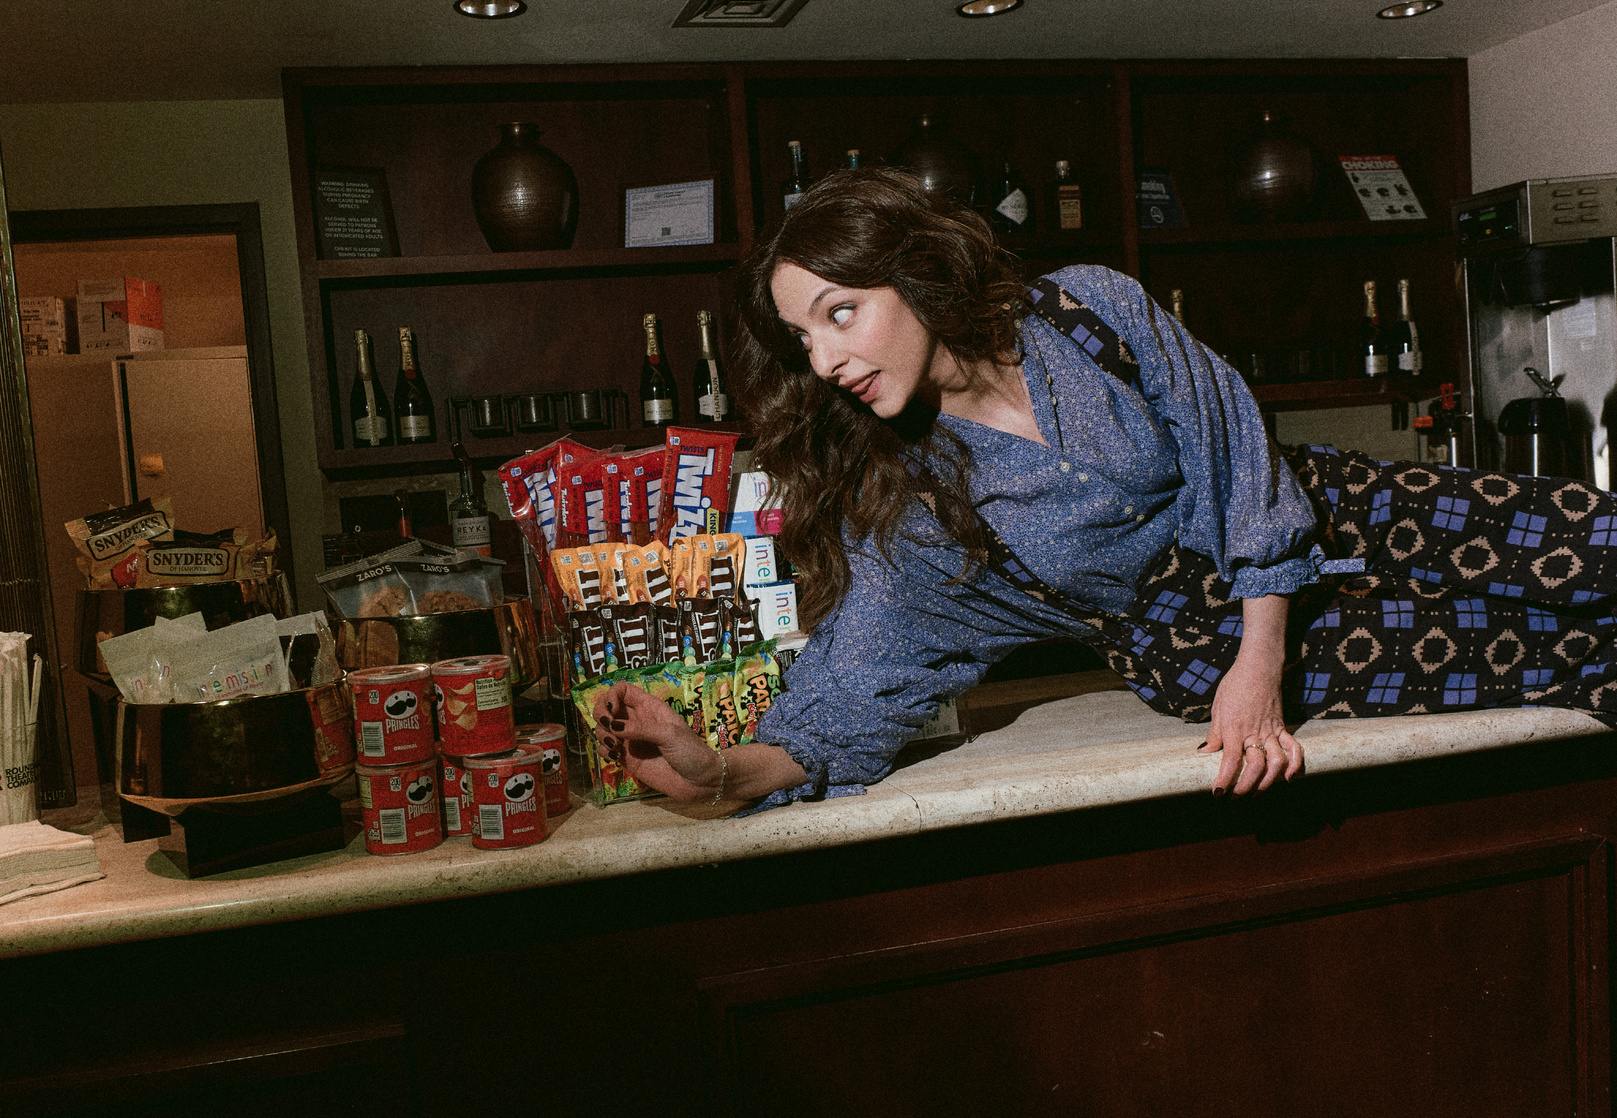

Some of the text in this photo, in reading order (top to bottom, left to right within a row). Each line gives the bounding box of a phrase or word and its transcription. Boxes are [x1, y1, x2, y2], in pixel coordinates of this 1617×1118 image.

[1342, 160, 1398, 170] CHOKING
[712, 376, 721, 419] CHANDON
[680, 445, 705, 454] TWISTS
[645, 468, 664, 479] TWIST
[583, 480, 602, 489] TWIST
[94, 516, 160, 552] SNYDER'S
[457, 525, 487, 534] REYKA
[153, 552, 224, 566] SNYDER'S
[356, 565, 392, 582] ZARO'S
[420, 564, 450, 573] ZARO'S
[194, 663, 273, 699] intermission
[370, 691, 379, 699] 200
[386, 714, 419, 734] PRINGLES
[5, 763, 35, 776] ROUND
[446, 768, 455, 776] 200
[6, 770, 36, 782] THEATR
[391, 777, 400, 786] 200
[489, 774, 498, 782] 200
[408, 798, 436, 820] PRINGLES
[505, 796, 536, 817] PRINGLES
[513, 825, 535, 834] ORIGINAL
